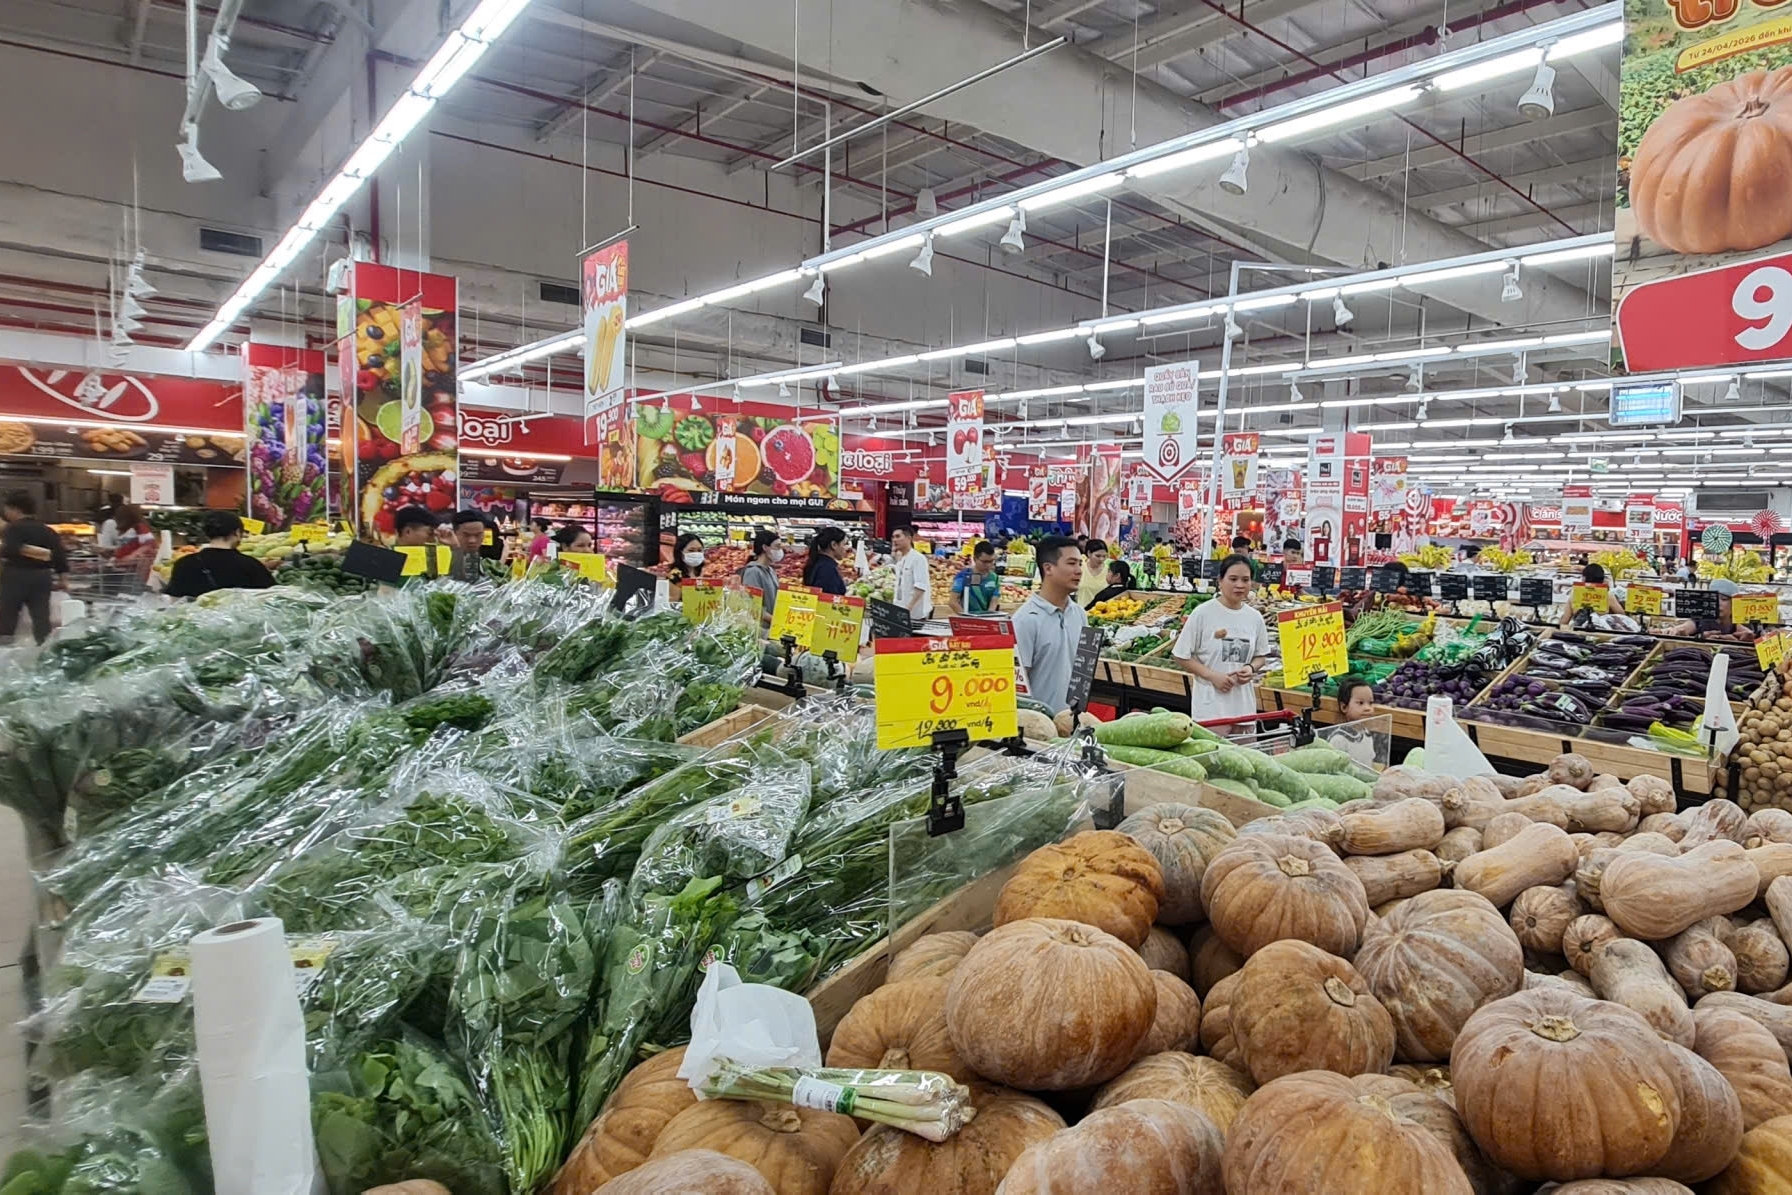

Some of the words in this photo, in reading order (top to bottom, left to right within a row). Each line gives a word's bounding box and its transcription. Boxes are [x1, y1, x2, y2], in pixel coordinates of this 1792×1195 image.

[1702, 35, 1757, 56] 24/04/2026
[596, 251, 619, 298] GIÁ
[958, 396, 978, 416] GIÁ
[1233, 437, 1252, 452] GIÁ
[954, 477, 967, 491] 59
[724, 494, 742, 503] Món
[746, 497, 769, 505] ngon
[772, 496, 791, 504] cho
[793, 496, 805, 507] mọi
[808, 498, 824, 506] GU!
